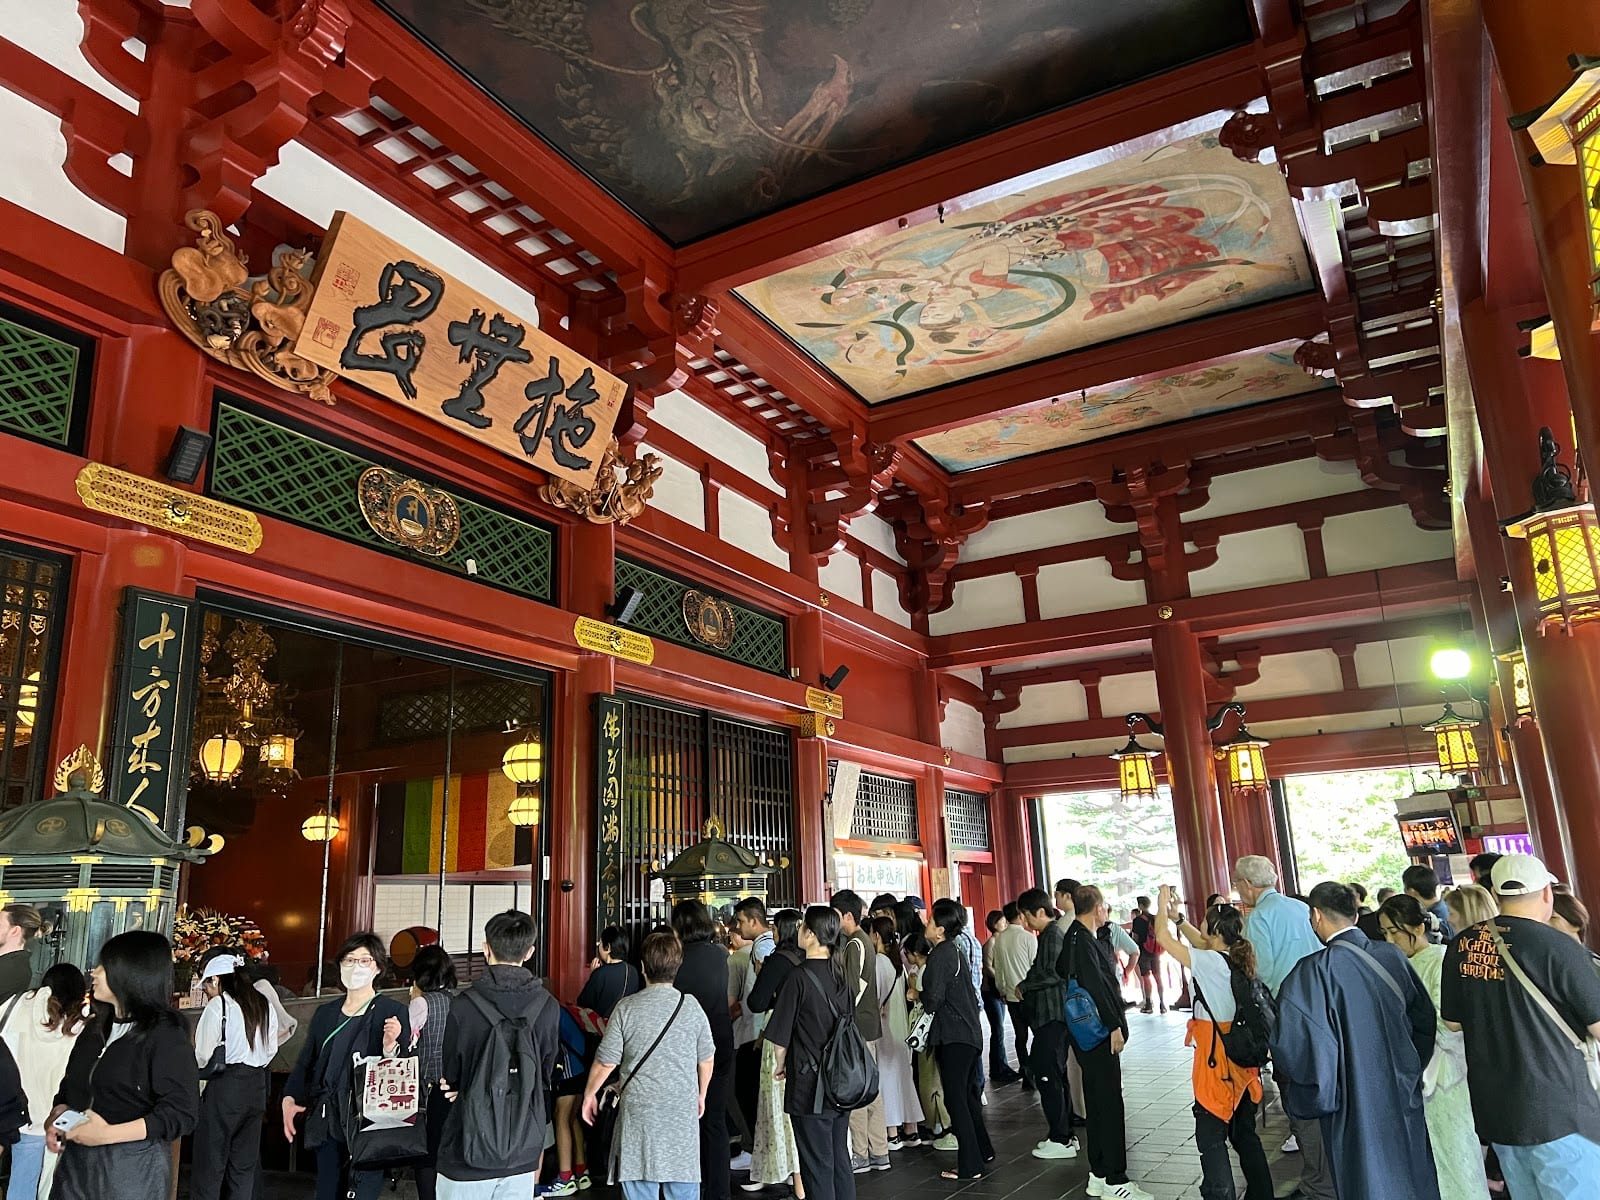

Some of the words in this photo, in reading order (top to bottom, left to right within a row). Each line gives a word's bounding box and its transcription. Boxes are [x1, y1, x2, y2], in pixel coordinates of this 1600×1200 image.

[856, 864, 904, 887] お札申込所
[1458, 936, 1513, 955] NIGHTME
[1467, 951, 1501, 968] BEFORE
